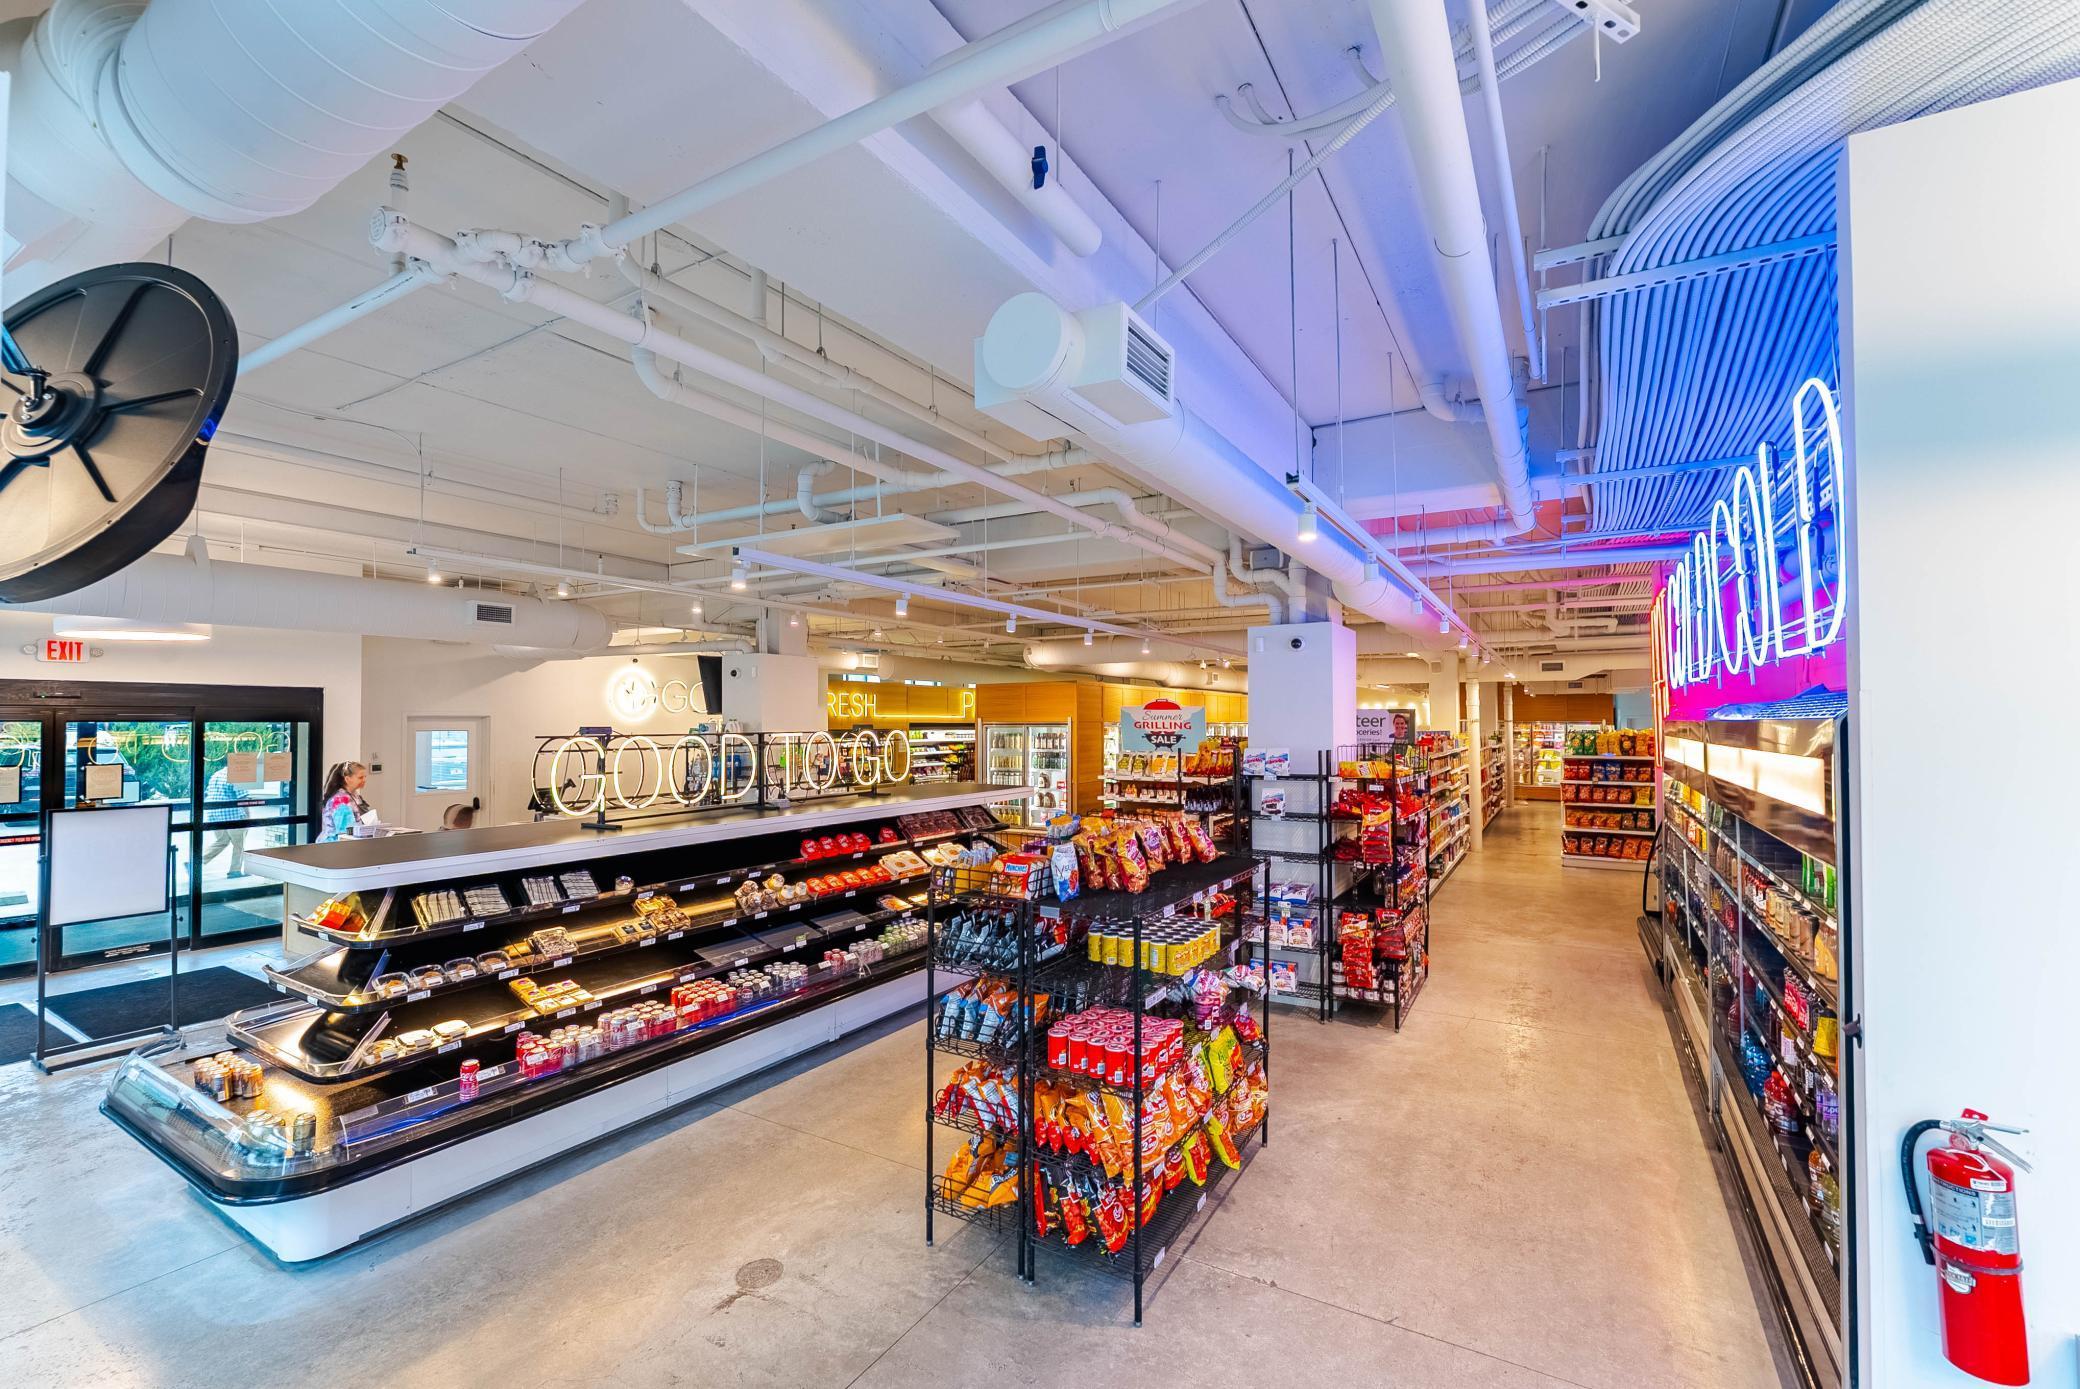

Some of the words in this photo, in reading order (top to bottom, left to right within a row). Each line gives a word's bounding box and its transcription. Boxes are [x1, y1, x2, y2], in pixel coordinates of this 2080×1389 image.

[47, 640, 84, 661] EXIT
[1142, 705, 1184, 721] Summer
[1133, 721, 1192, 730] GRILLING
[1150, 735, 1177, 744] SALE
[551, 733, 756, 816] GOOD
[769, 731, 837, 793] TO
[853, 730, 911, 786] GO
